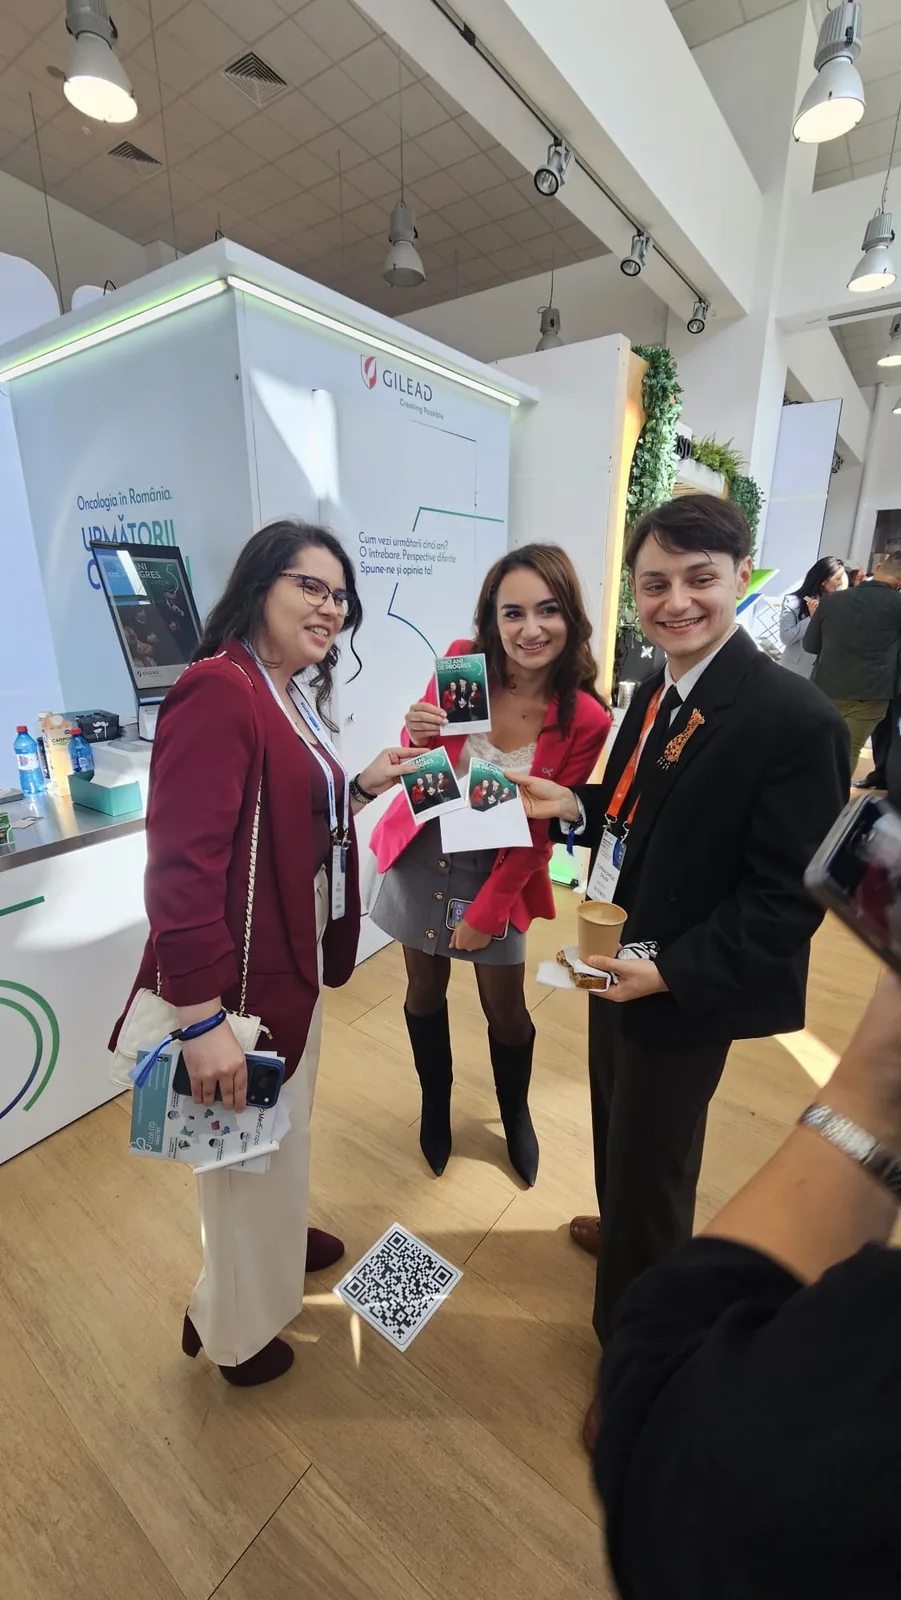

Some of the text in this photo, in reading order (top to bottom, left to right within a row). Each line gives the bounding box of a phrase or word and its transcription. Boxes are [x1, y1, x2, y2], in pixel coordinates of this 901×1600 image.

[383, 369, 433, 401] GILEAD
[399, 398, 423, 415] Creating
[76, 485, 173, 511] Oncologia în România.
[359, 532, 449, 551] Cum vezi următorii cinci ani?
[359, 545, 367, 558] O
[402, 548, 436, 563] Perspective
[360, 561, 395, 575] Spune-ne
[402, 565, 423, 577] opinia
[424, 564, 433, 576] ta!
